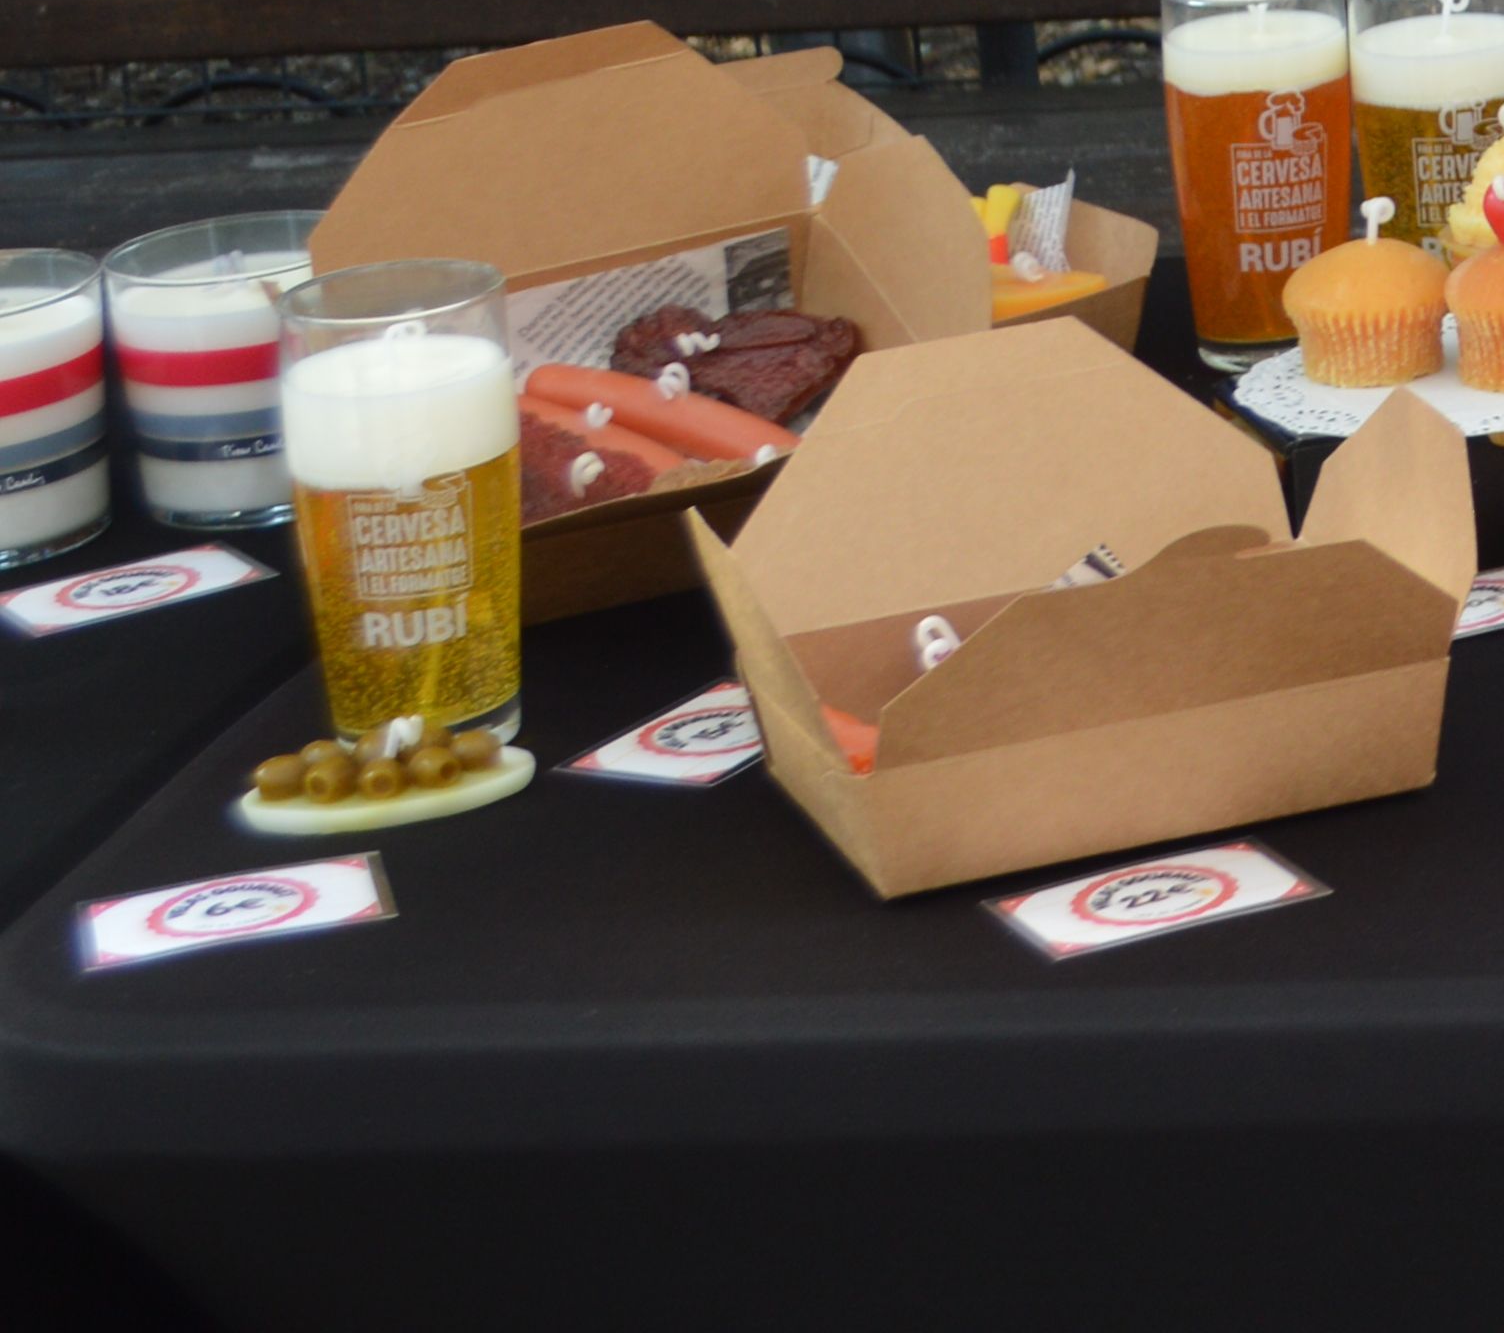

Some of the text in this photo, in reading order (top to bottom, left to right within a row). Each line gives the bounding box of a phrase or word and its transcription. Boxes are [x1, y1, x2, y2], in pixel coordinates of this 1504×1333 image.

[1236, 154, 1323, 186] CERVESA
[1241, 181, 1323, 209] ARTESANA
[1239, 227, 1322, 272] RUBÍ
[355, 504, 467, 545] CERVESA
[360, 538, 467, 573] ARTESANA
[362, 592, 468, 648] RUBÍ
